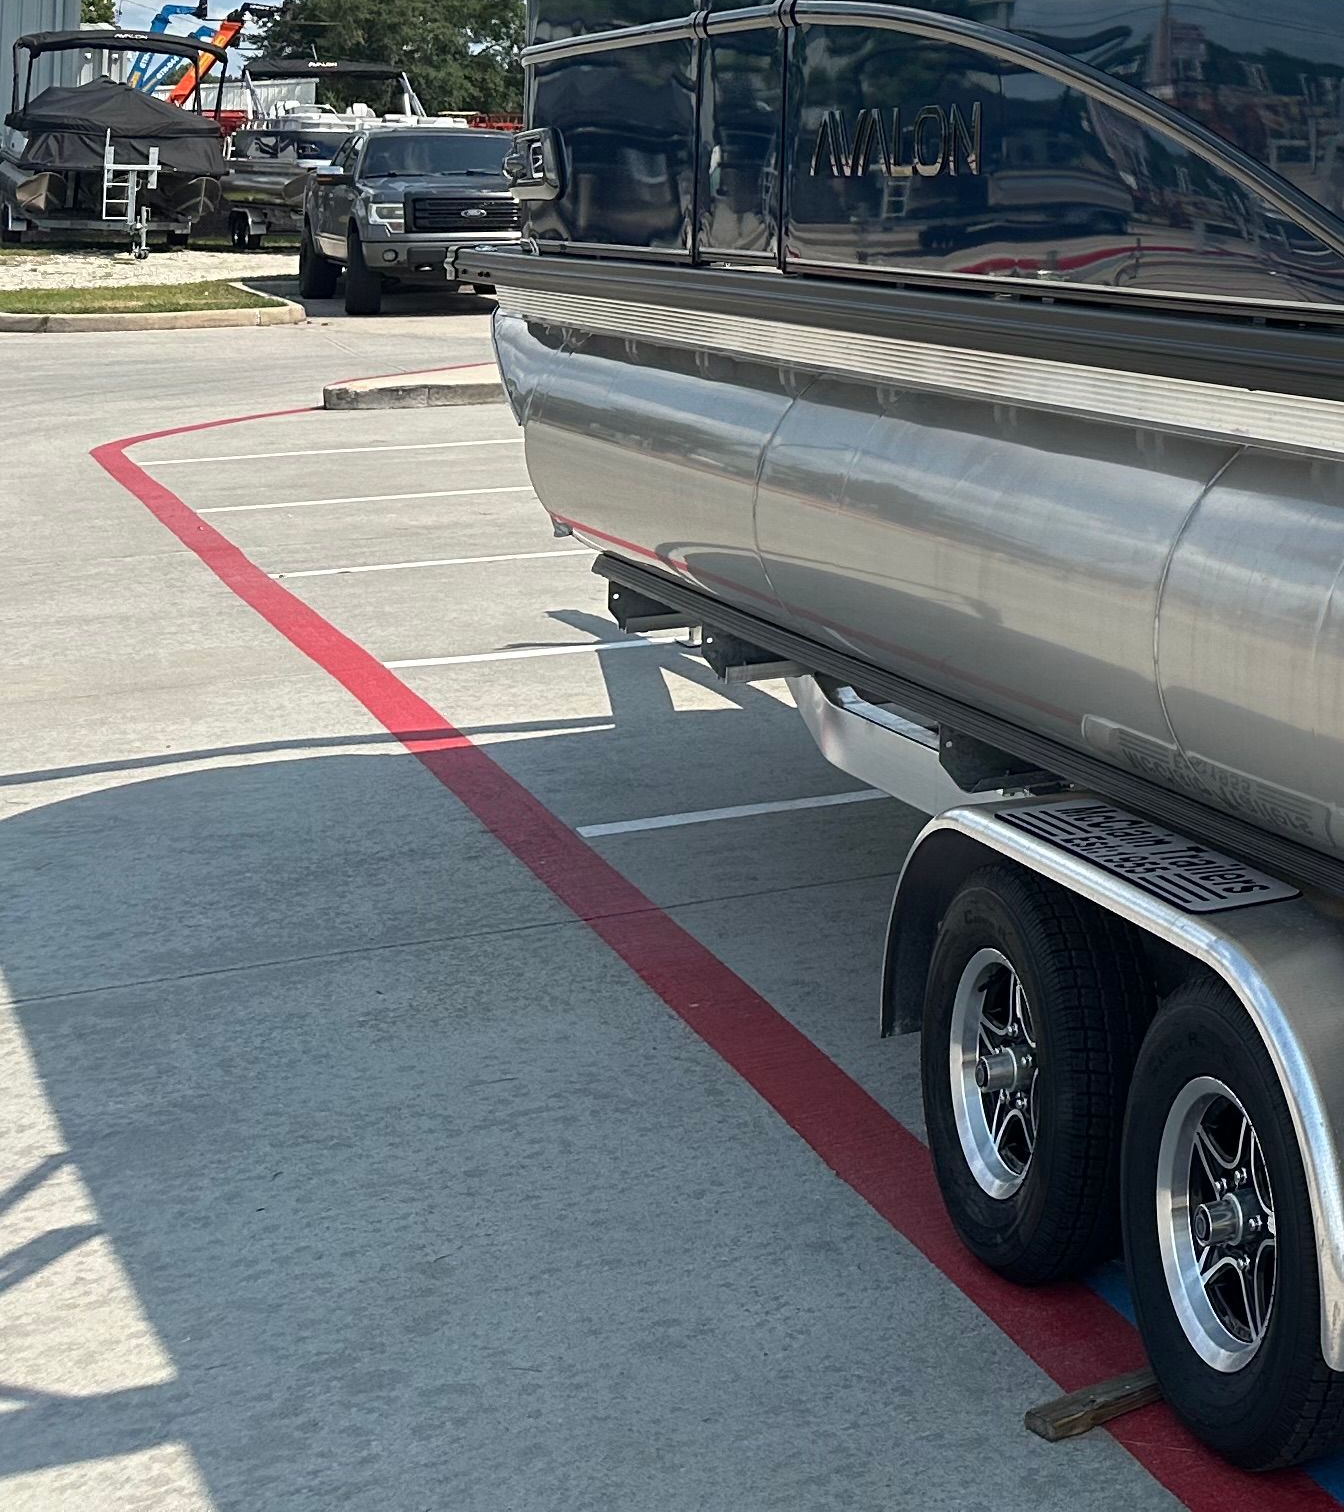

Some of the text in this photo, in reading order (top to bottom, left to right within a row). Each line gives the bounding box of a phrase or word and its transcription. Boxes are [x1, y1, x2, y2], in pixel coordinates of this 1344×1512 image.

[809, 101, 982, 177] AVALON
[1055, 805, 1271, 894] McClain Trailers
